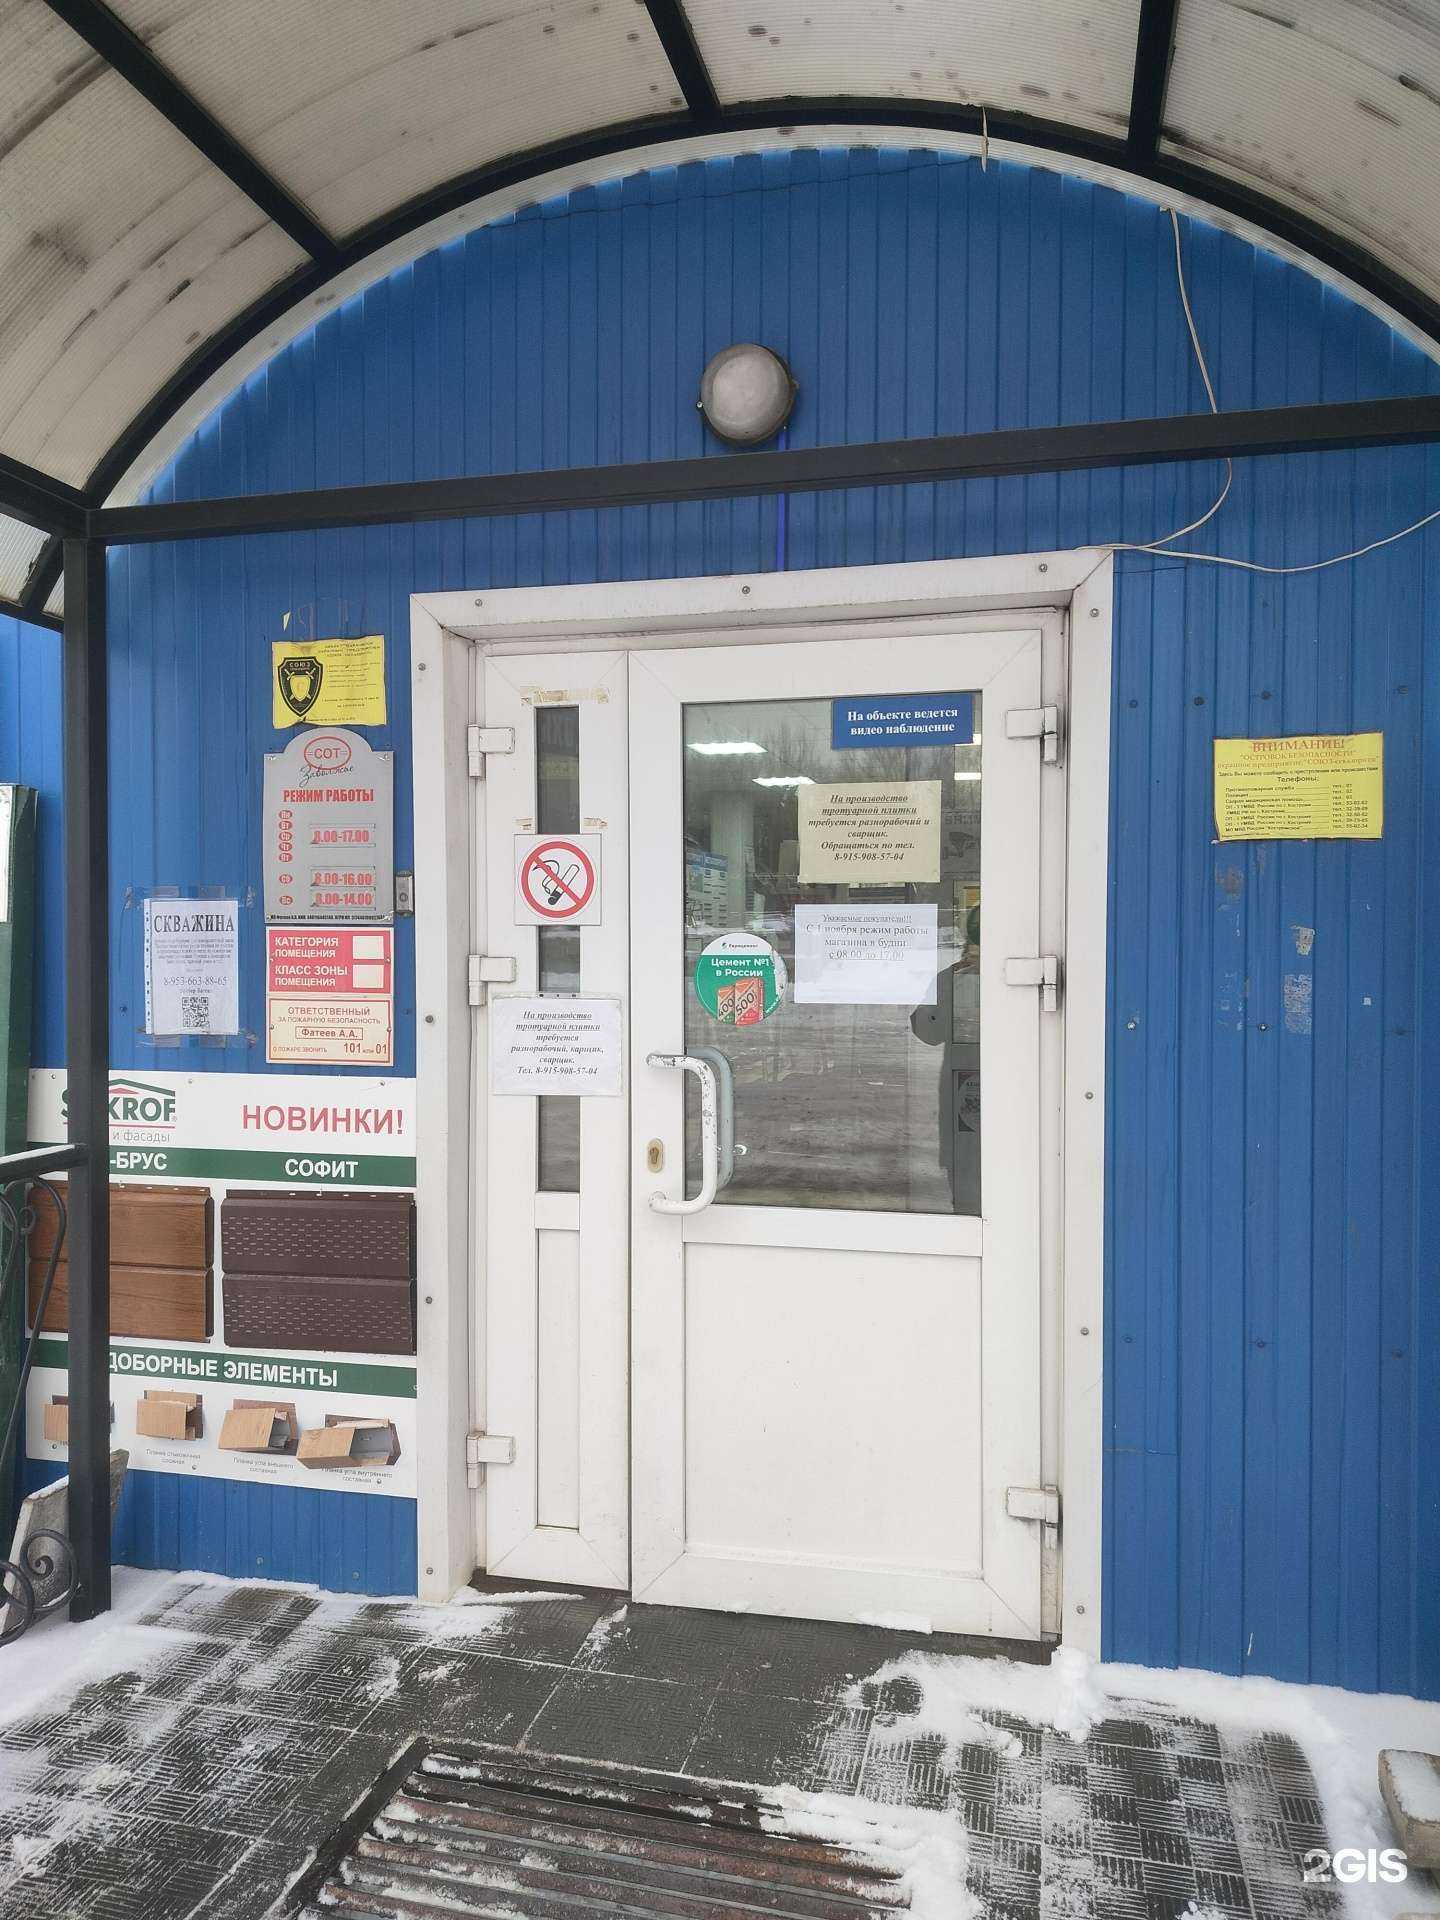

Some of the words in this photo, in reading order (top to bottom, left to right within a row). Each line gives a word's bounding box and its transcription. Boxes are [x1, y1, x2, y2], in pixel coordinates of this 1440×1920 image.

[847, 711, 864, 722] На
[866, 710, 912, 721] объекте
[914, 708, 959, 720] ведется
[850, 725, 883, 736] видео
[886, 723, 956, 735] наблюдение
[1251, 738, 1345, 752] ВНИМАНИЕ!
[314, 747, 341, 760] СОТ
[283, 789, 323, 803] РЕЖИМ
[326, 788, 374, 802] РАБОТЫ
[830, 794, 843, 803] На
[846, 793, 909, 804] производство
[821, 806, 878, 816] тротуарной
[880, 806, 917, 815] плитки
[808, 818, 857, 828] требуется
[858, 817, 922, 828] разнорабочий
[847, 830, 889, 839] сварщик.
[821, 841, 880, 852] Обращаться
[881, 843, 893, 851] по
[895, 842, 916, 850] тел.
[834, 852, 905, 862] 8-915-908-57-04
[154, 914, 235, 933] СКВАЖИНА
[824, 924, 858, 936] ноября
[860, 927, 891, 937] режим
[893, 925, 929, 937] работы
[275, 937, 339, 947] КАТЕГОРИЯ
[824, 939, 867, 947] магазина
[878, 937, 906, 949] будни
[275, 949, 336, 960] ПОМЕЩЕНИЯ
[711, 958, 751, 967] Цемент
[754, 958, 770, 967] №1
[275, 965, 312, 975] КЛАСС
[314, 966, 348, 976] ЗОНЫ
[725, 968, 763, 977] России
[275, 978, 336, 988] ПОМЕЩЕНИЯ
[718, 998, 735, 1017] 400
[735, 991, 755, 1017] 500
[288, 1006, 371, 1016] ОТВЕТСТВЕННЫЙ
[523, 1011, 535, 1020] На
[537, 1012, 592, 1020] производство
[515, 1023, 567, 1031] тротуарной
[569, 1023, 601, 1031] плитки
[301, 1028, 336, 1038] Фатеев
[339, 1029, 358, 1038] А.А.
[536, 1034, 579, 1043] требуется
[343, 1043, 361, 1054] 101
[376, 1044, 388, 1054] 01
[517, 1066, 533, 1075] Тел.
[535, 1066, 598, 1075] 8-915-908-57-04
[242, 1104, 404, 1135] НОВИНКИ!
[113, 1132, 120, 1141] и
[123, 1130, 171, 1143] фасады
[109, 1151, 168, 1171] -БРУС
[284, 1157, 359, 1180] СОФИТ
[223, 1360, 338, 1387] ЭЛЕМЕНТЫ
